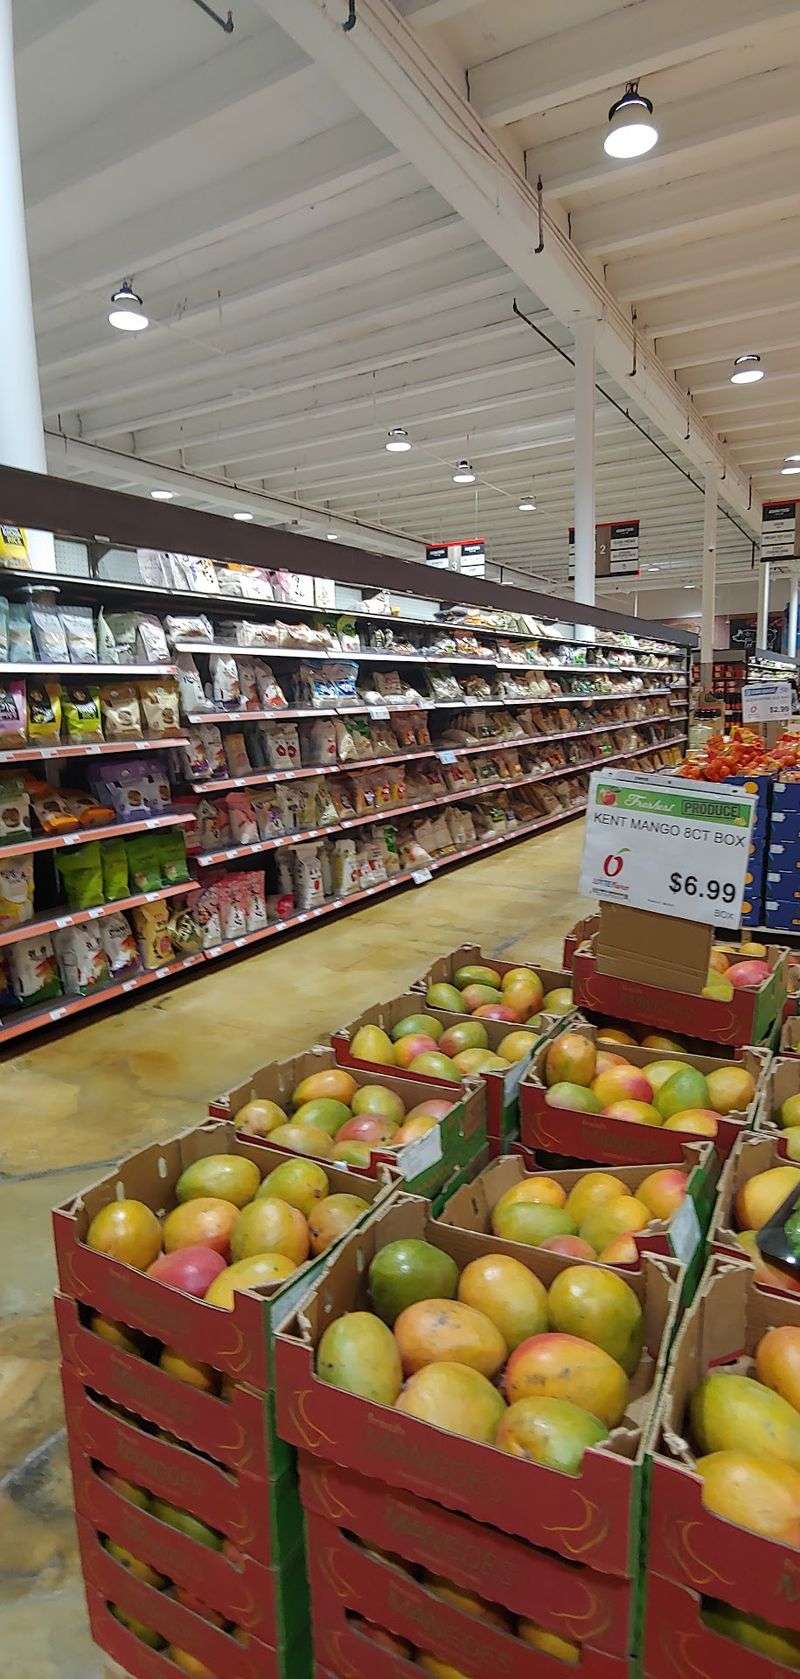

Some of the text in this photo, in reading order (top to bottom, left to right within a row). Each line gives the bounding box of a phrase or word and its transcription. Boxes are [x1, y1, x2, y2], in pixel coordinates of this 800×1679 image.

[599, 544, 606, 555] 2
[624, 793, 739, 818] Freshest PRODUCE
[593, 812, 747, 848] KENT MANGO 8CT BOX
[668, 872, 736, 904] $6.99
[714, 909, 735, 919] BOX
